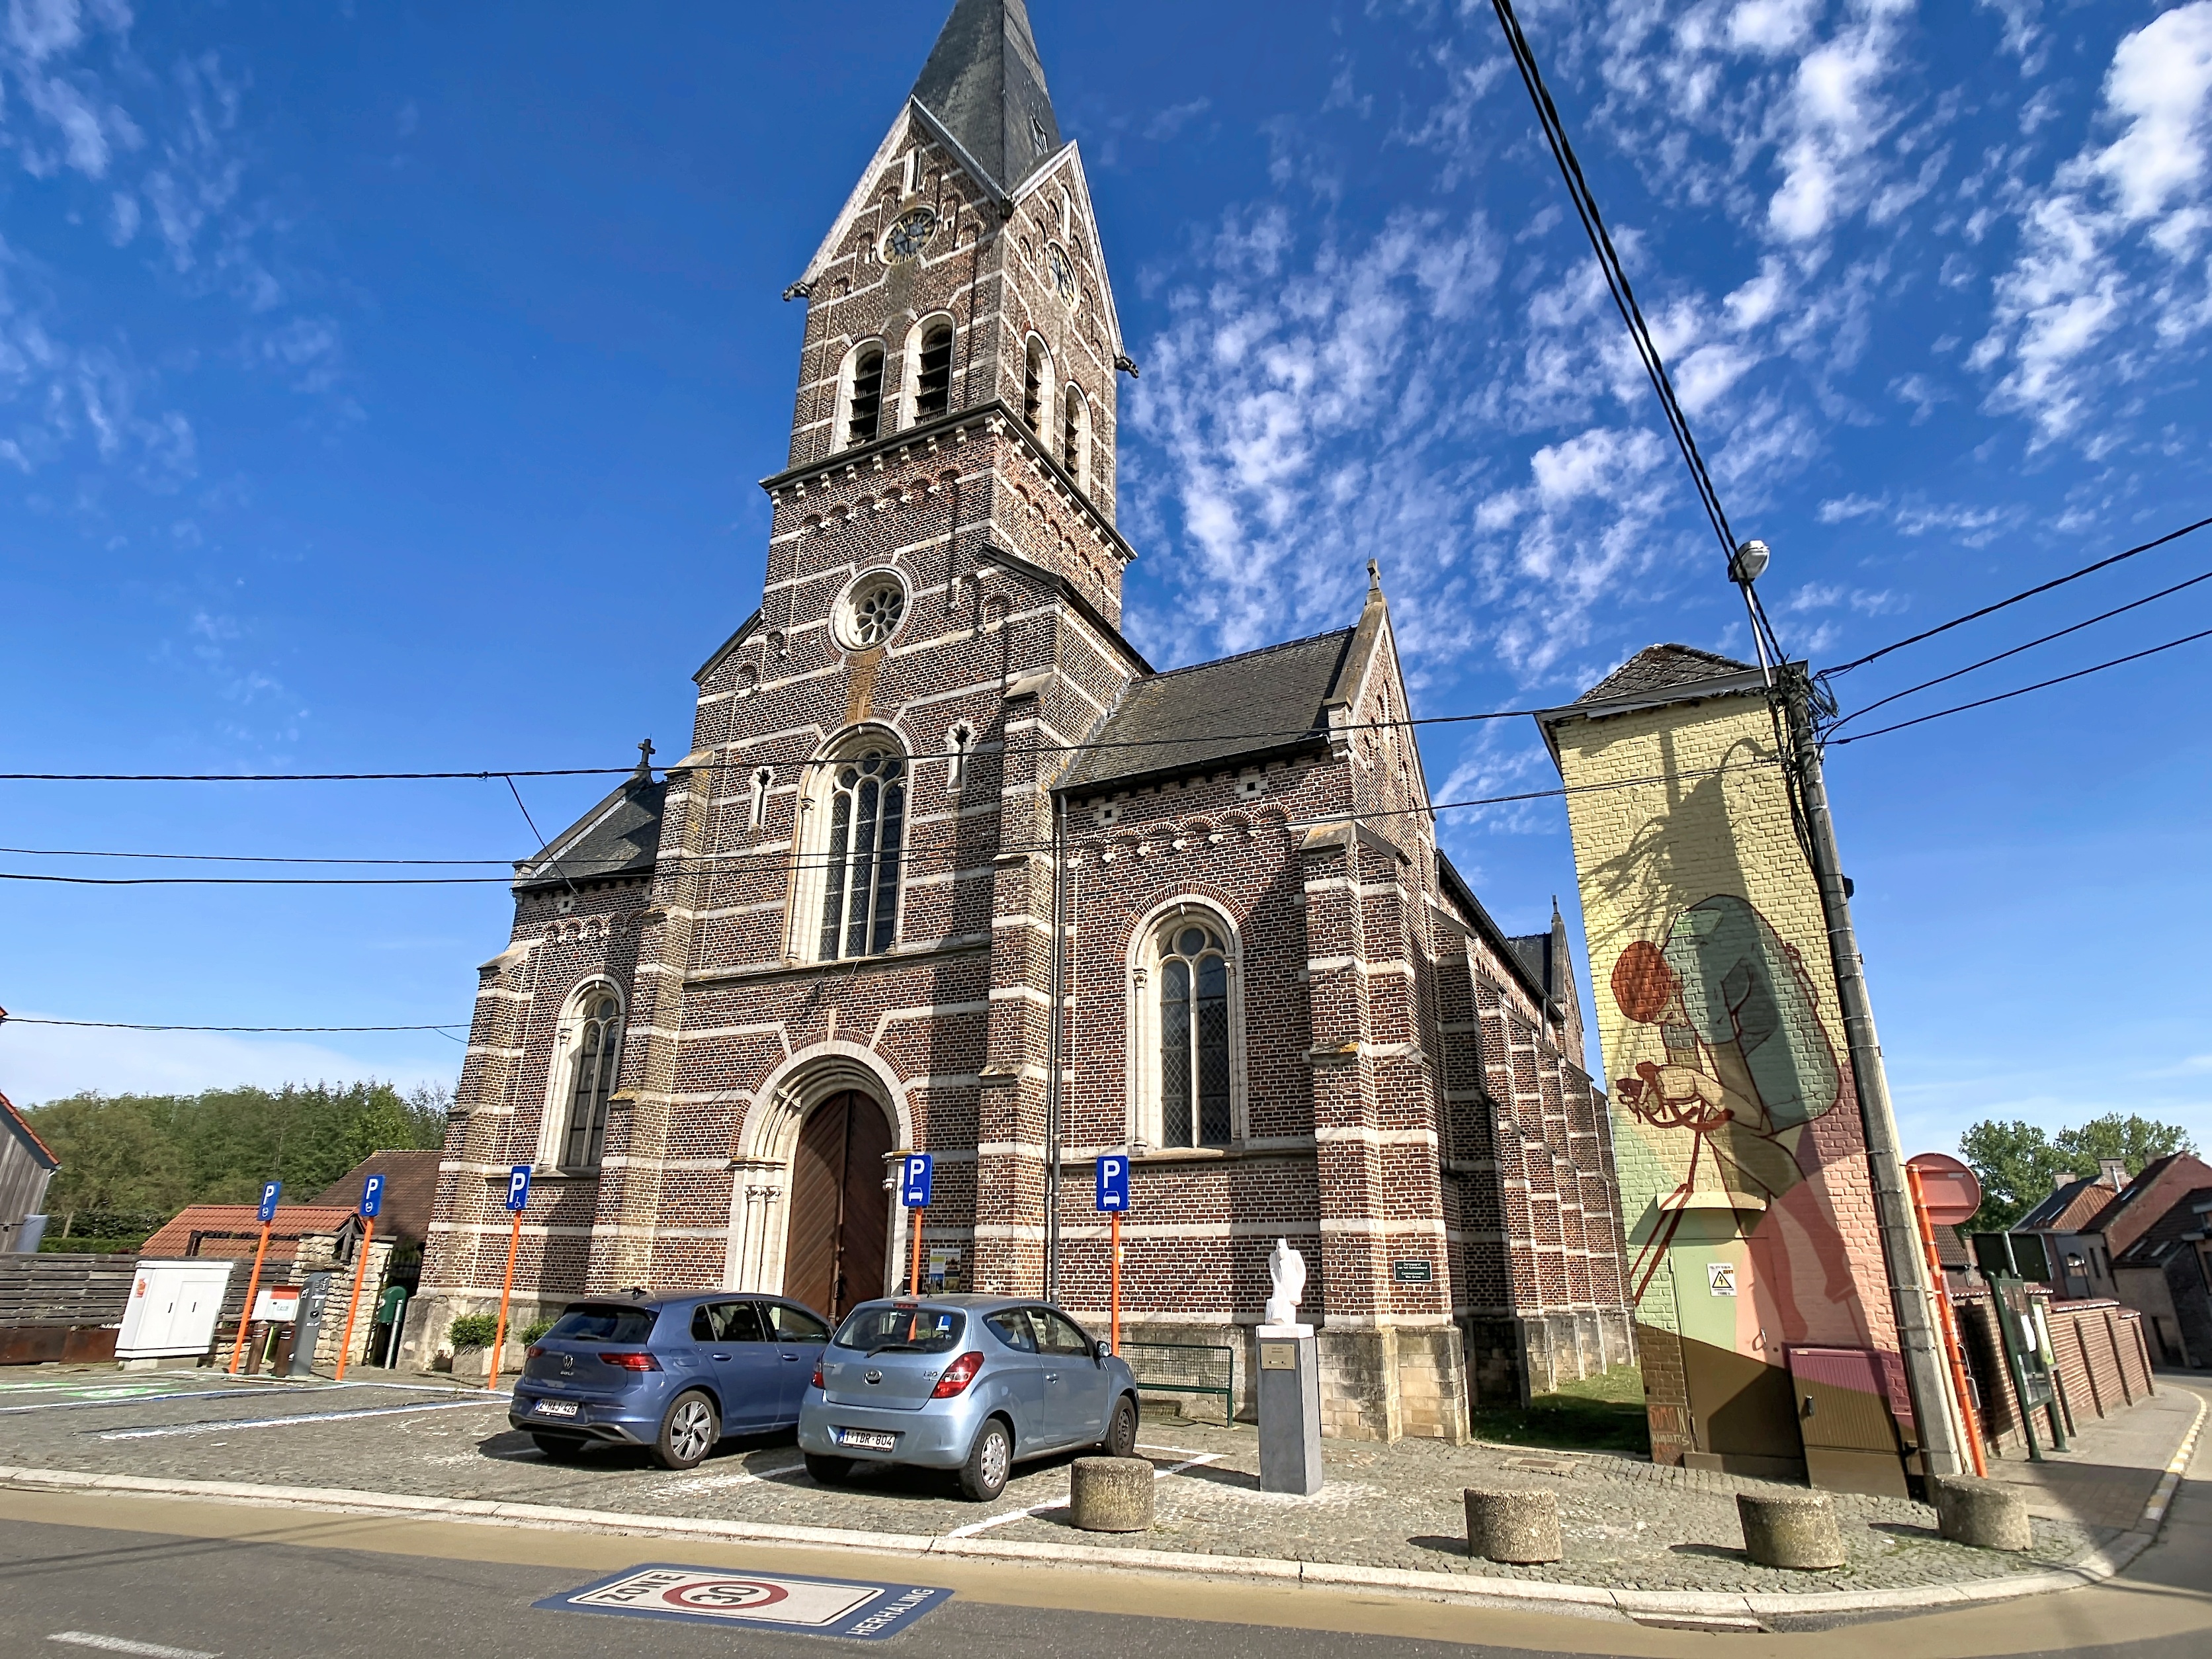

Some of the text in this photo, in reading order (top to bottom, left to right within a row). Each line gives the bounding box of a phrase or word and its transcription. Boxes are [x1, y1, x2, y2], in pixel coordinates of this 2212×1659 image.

[910, 1160, 925, 1185] P
[1103, 1160, 1120, 1189] P
[263, 1185, 275, 1205] P
[366, 1179, 378, 1199] P
[509, 1173, 526, 1203] P
[938, 1316, 949, 1328] L
[596, 1574, 687, 1601] ZONE
[690, 1586, 759, 1603] 30
[845, 1589, 935, 1636] HERHALING
